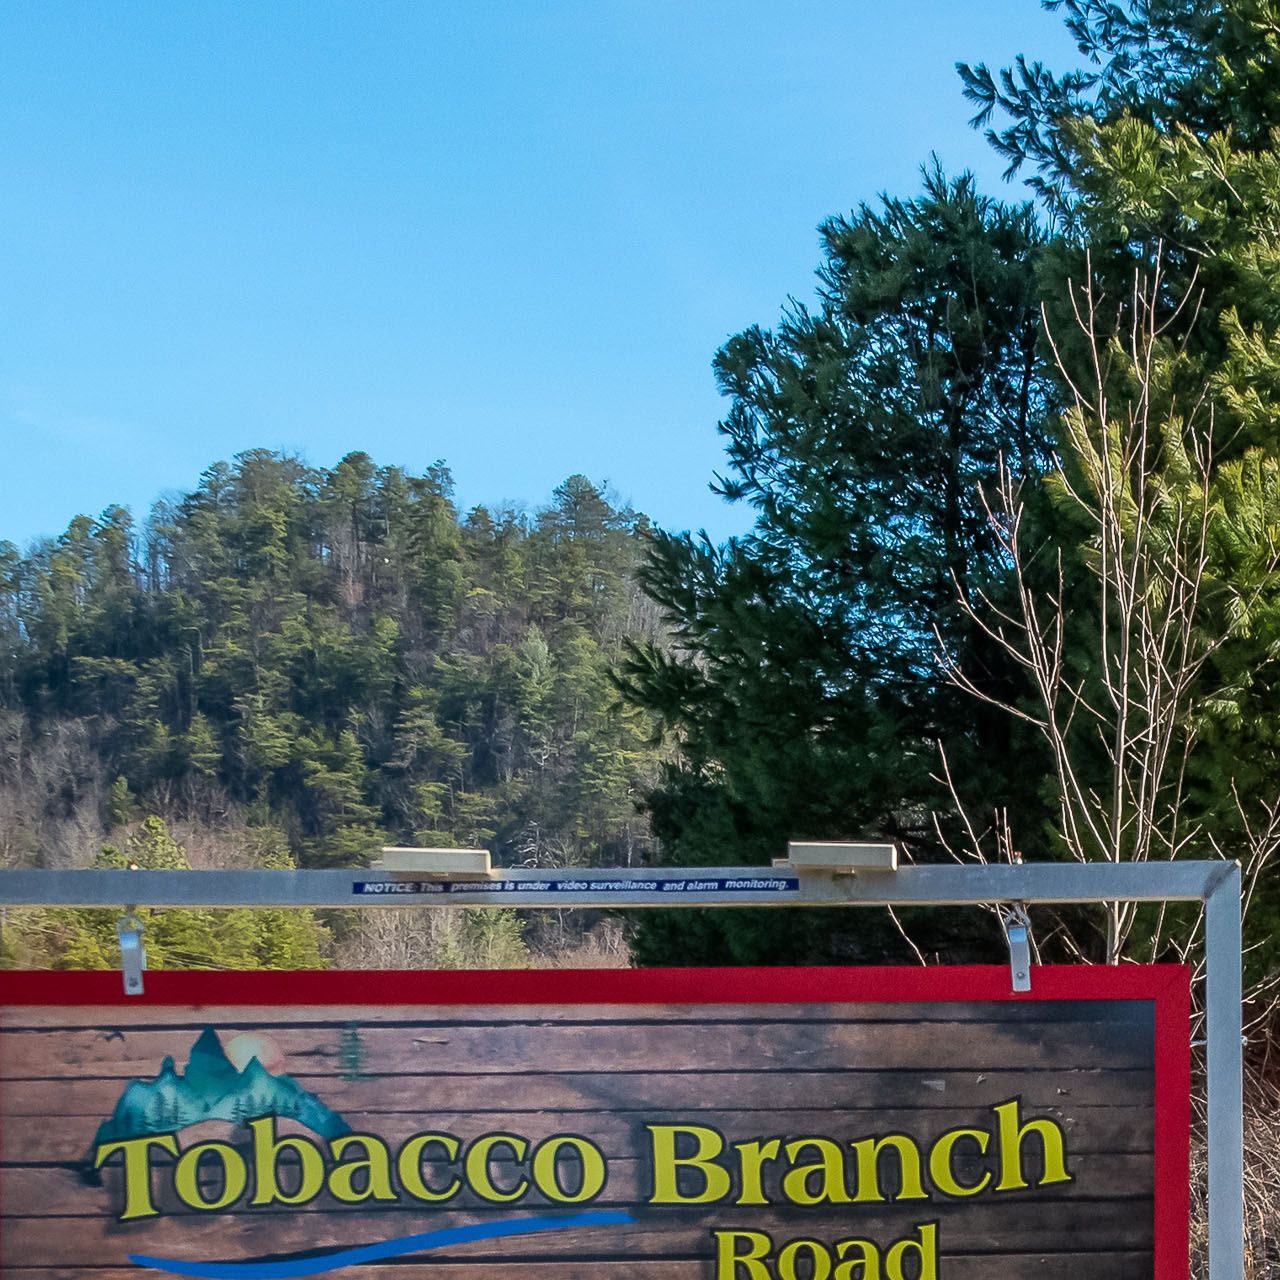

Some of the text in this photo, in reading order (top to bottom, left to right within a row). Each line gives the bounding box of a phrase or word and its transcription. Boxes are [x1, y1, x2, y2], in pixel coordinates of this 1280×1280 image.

[421, 882, 444, 892] This
[451, 881, 502, 891] premises
[504, 880, 515, 890] is
[517, 881, 551, 890] under
[556, 880, 588, 890] video
[589, 880, 657, 890] surveillance
[663, 881, 685, 891] and
[686, 881, 719, 890] alarm
[725, 879, 789, 890] monitoring.
[95, 1100, 1072, 1220] Tobacco Branch
